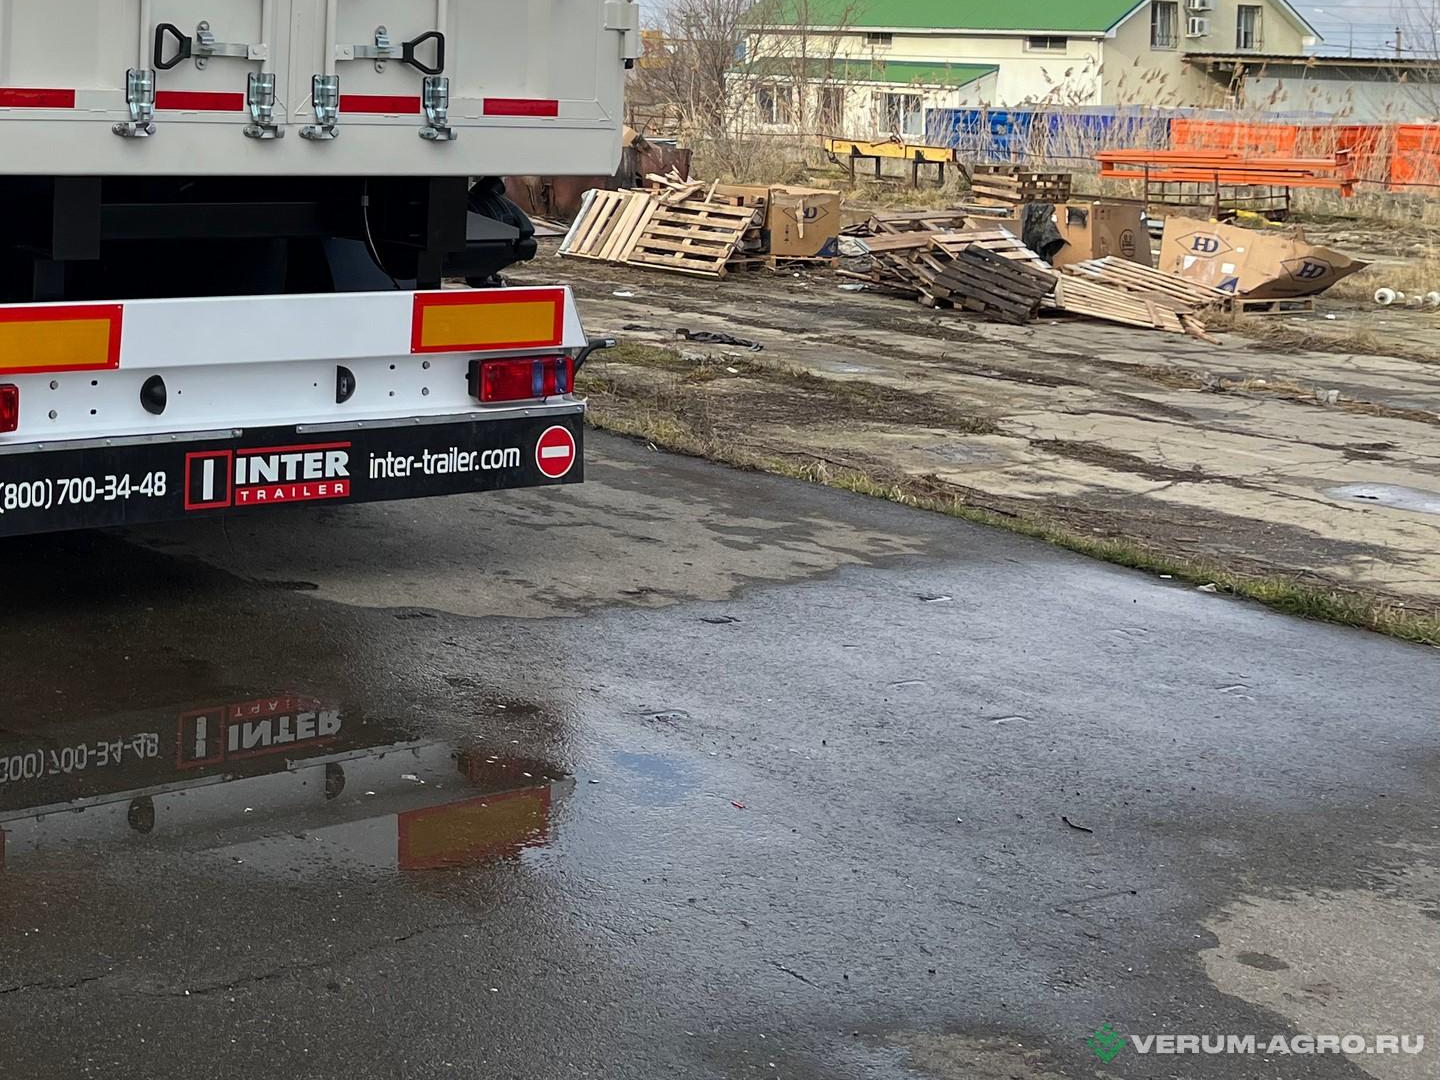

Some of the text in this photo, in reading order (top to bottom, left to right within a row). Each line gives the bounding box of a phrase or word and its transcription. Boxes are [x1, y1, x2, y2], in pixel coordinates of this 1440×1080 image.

[1191, 236, 1219, 253] HD
[1296, 261, 1325, 279] HD
[235, 450, 350, 484] INTER
[369, 447, 520, 479] inter-trailer.com
[56, 471, 166, 505] 700-34-48
[240, 483, 344, 501] TRAILER
